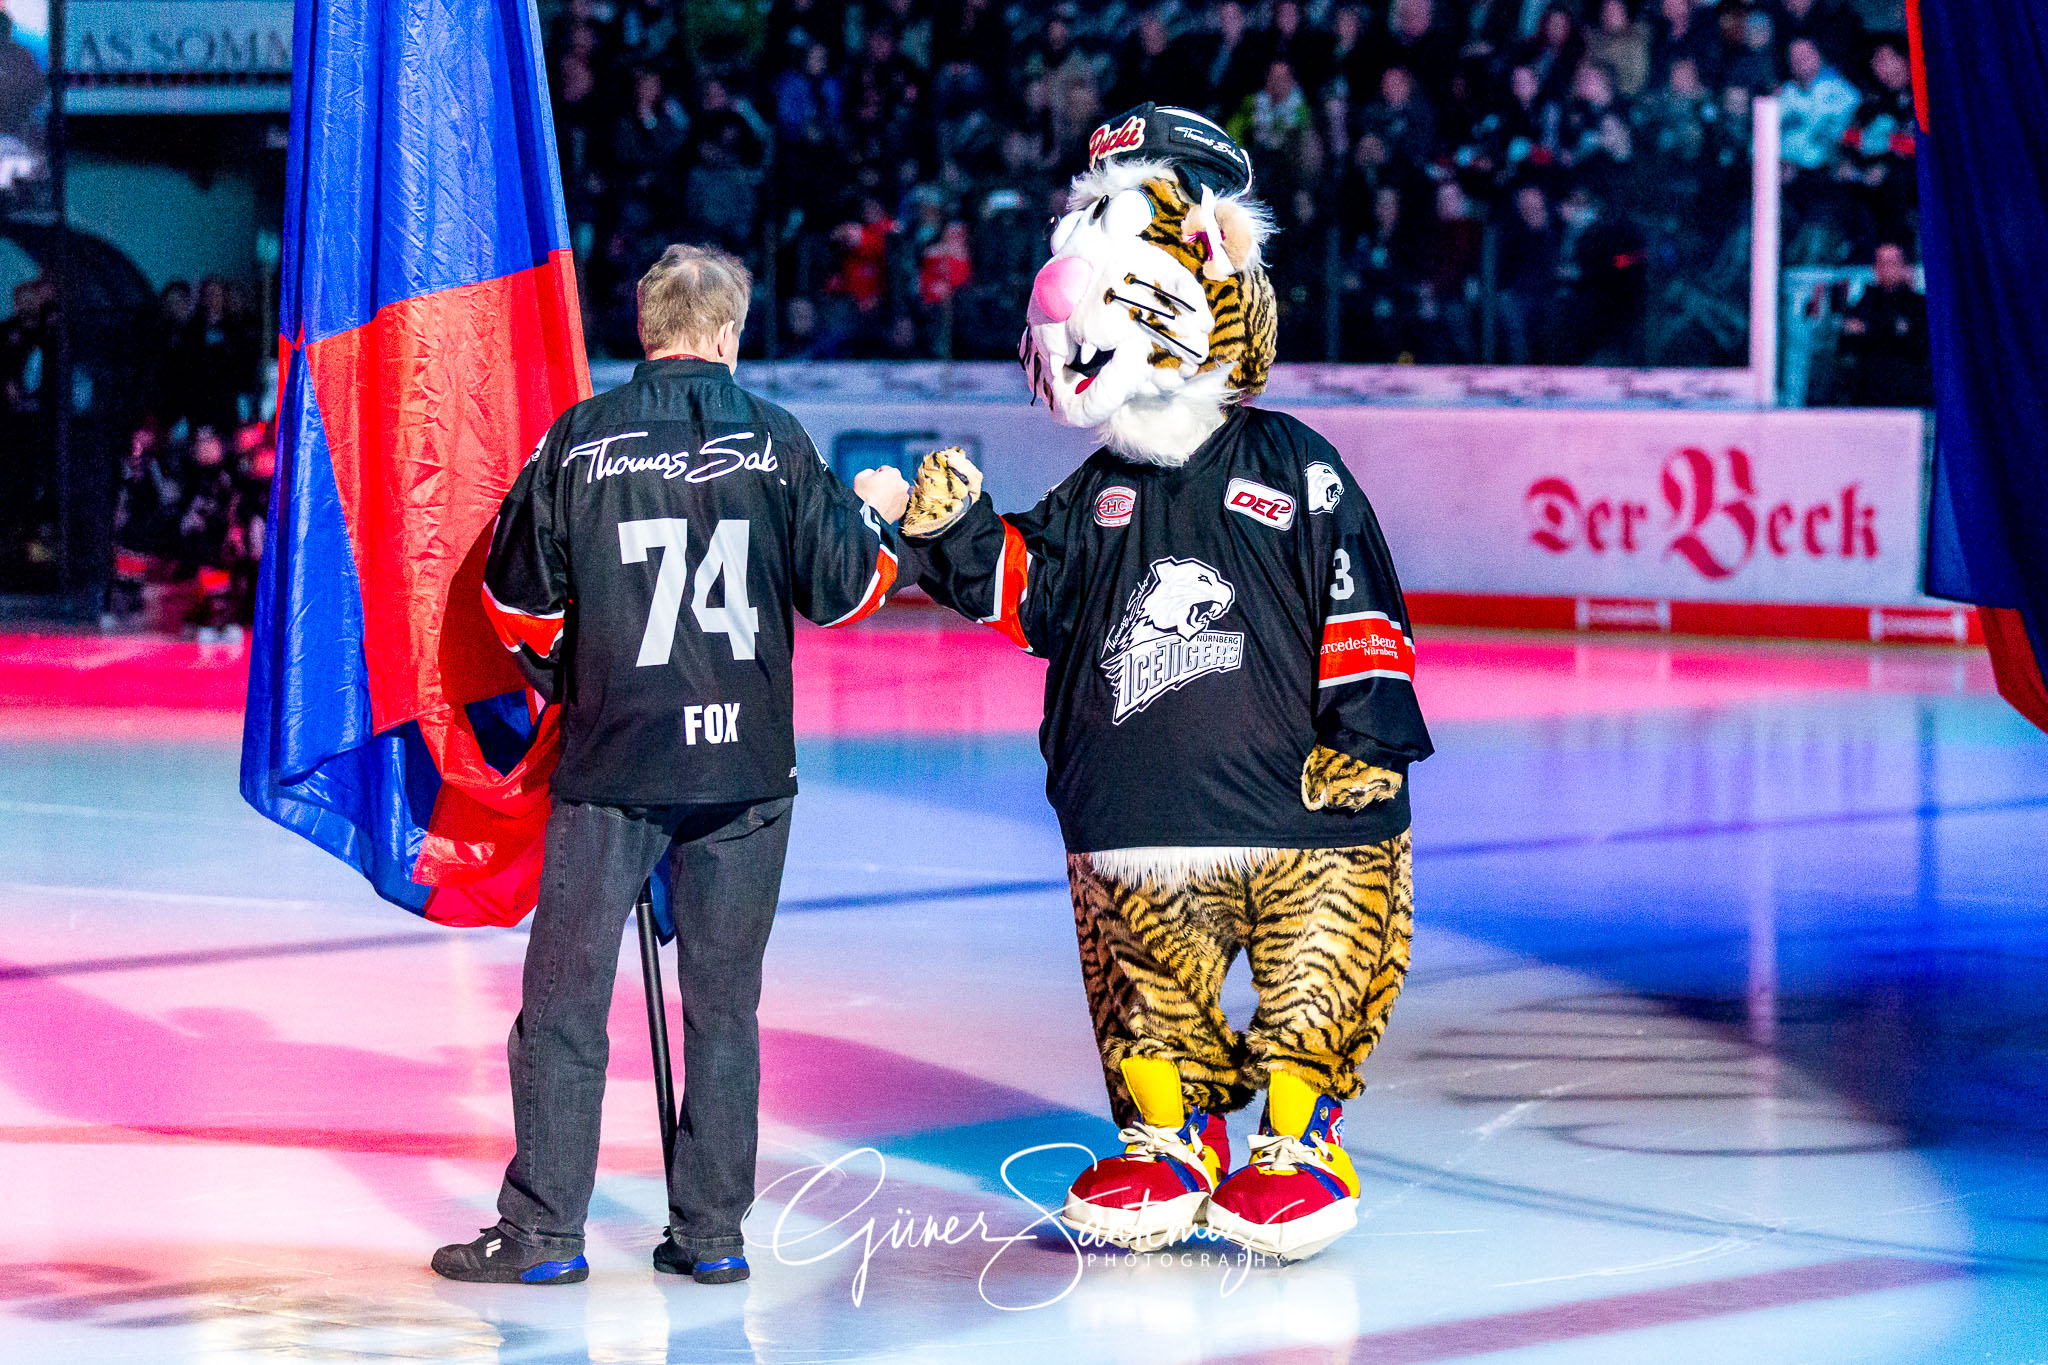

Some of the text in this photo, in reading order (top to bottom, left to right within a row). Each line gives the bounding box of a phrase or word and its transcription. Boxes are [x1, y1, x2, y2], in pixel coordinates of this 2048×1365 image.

[562, 431, 690, 484] Thomas
[685, 431, 787, 486] Sab
[1525, 445, 1879, 581] Der Beck
[617, 517, 760, 668] 74
[1329, 548, 1355, 601] 3
[1196, 634, 1239, 645] NÜRNBERG
[1320, 634, 1397, 655] ercedes-Benz
[1363, 647, 1399, 660] Nürnberg
[683, 702, 741, 746] FOX
